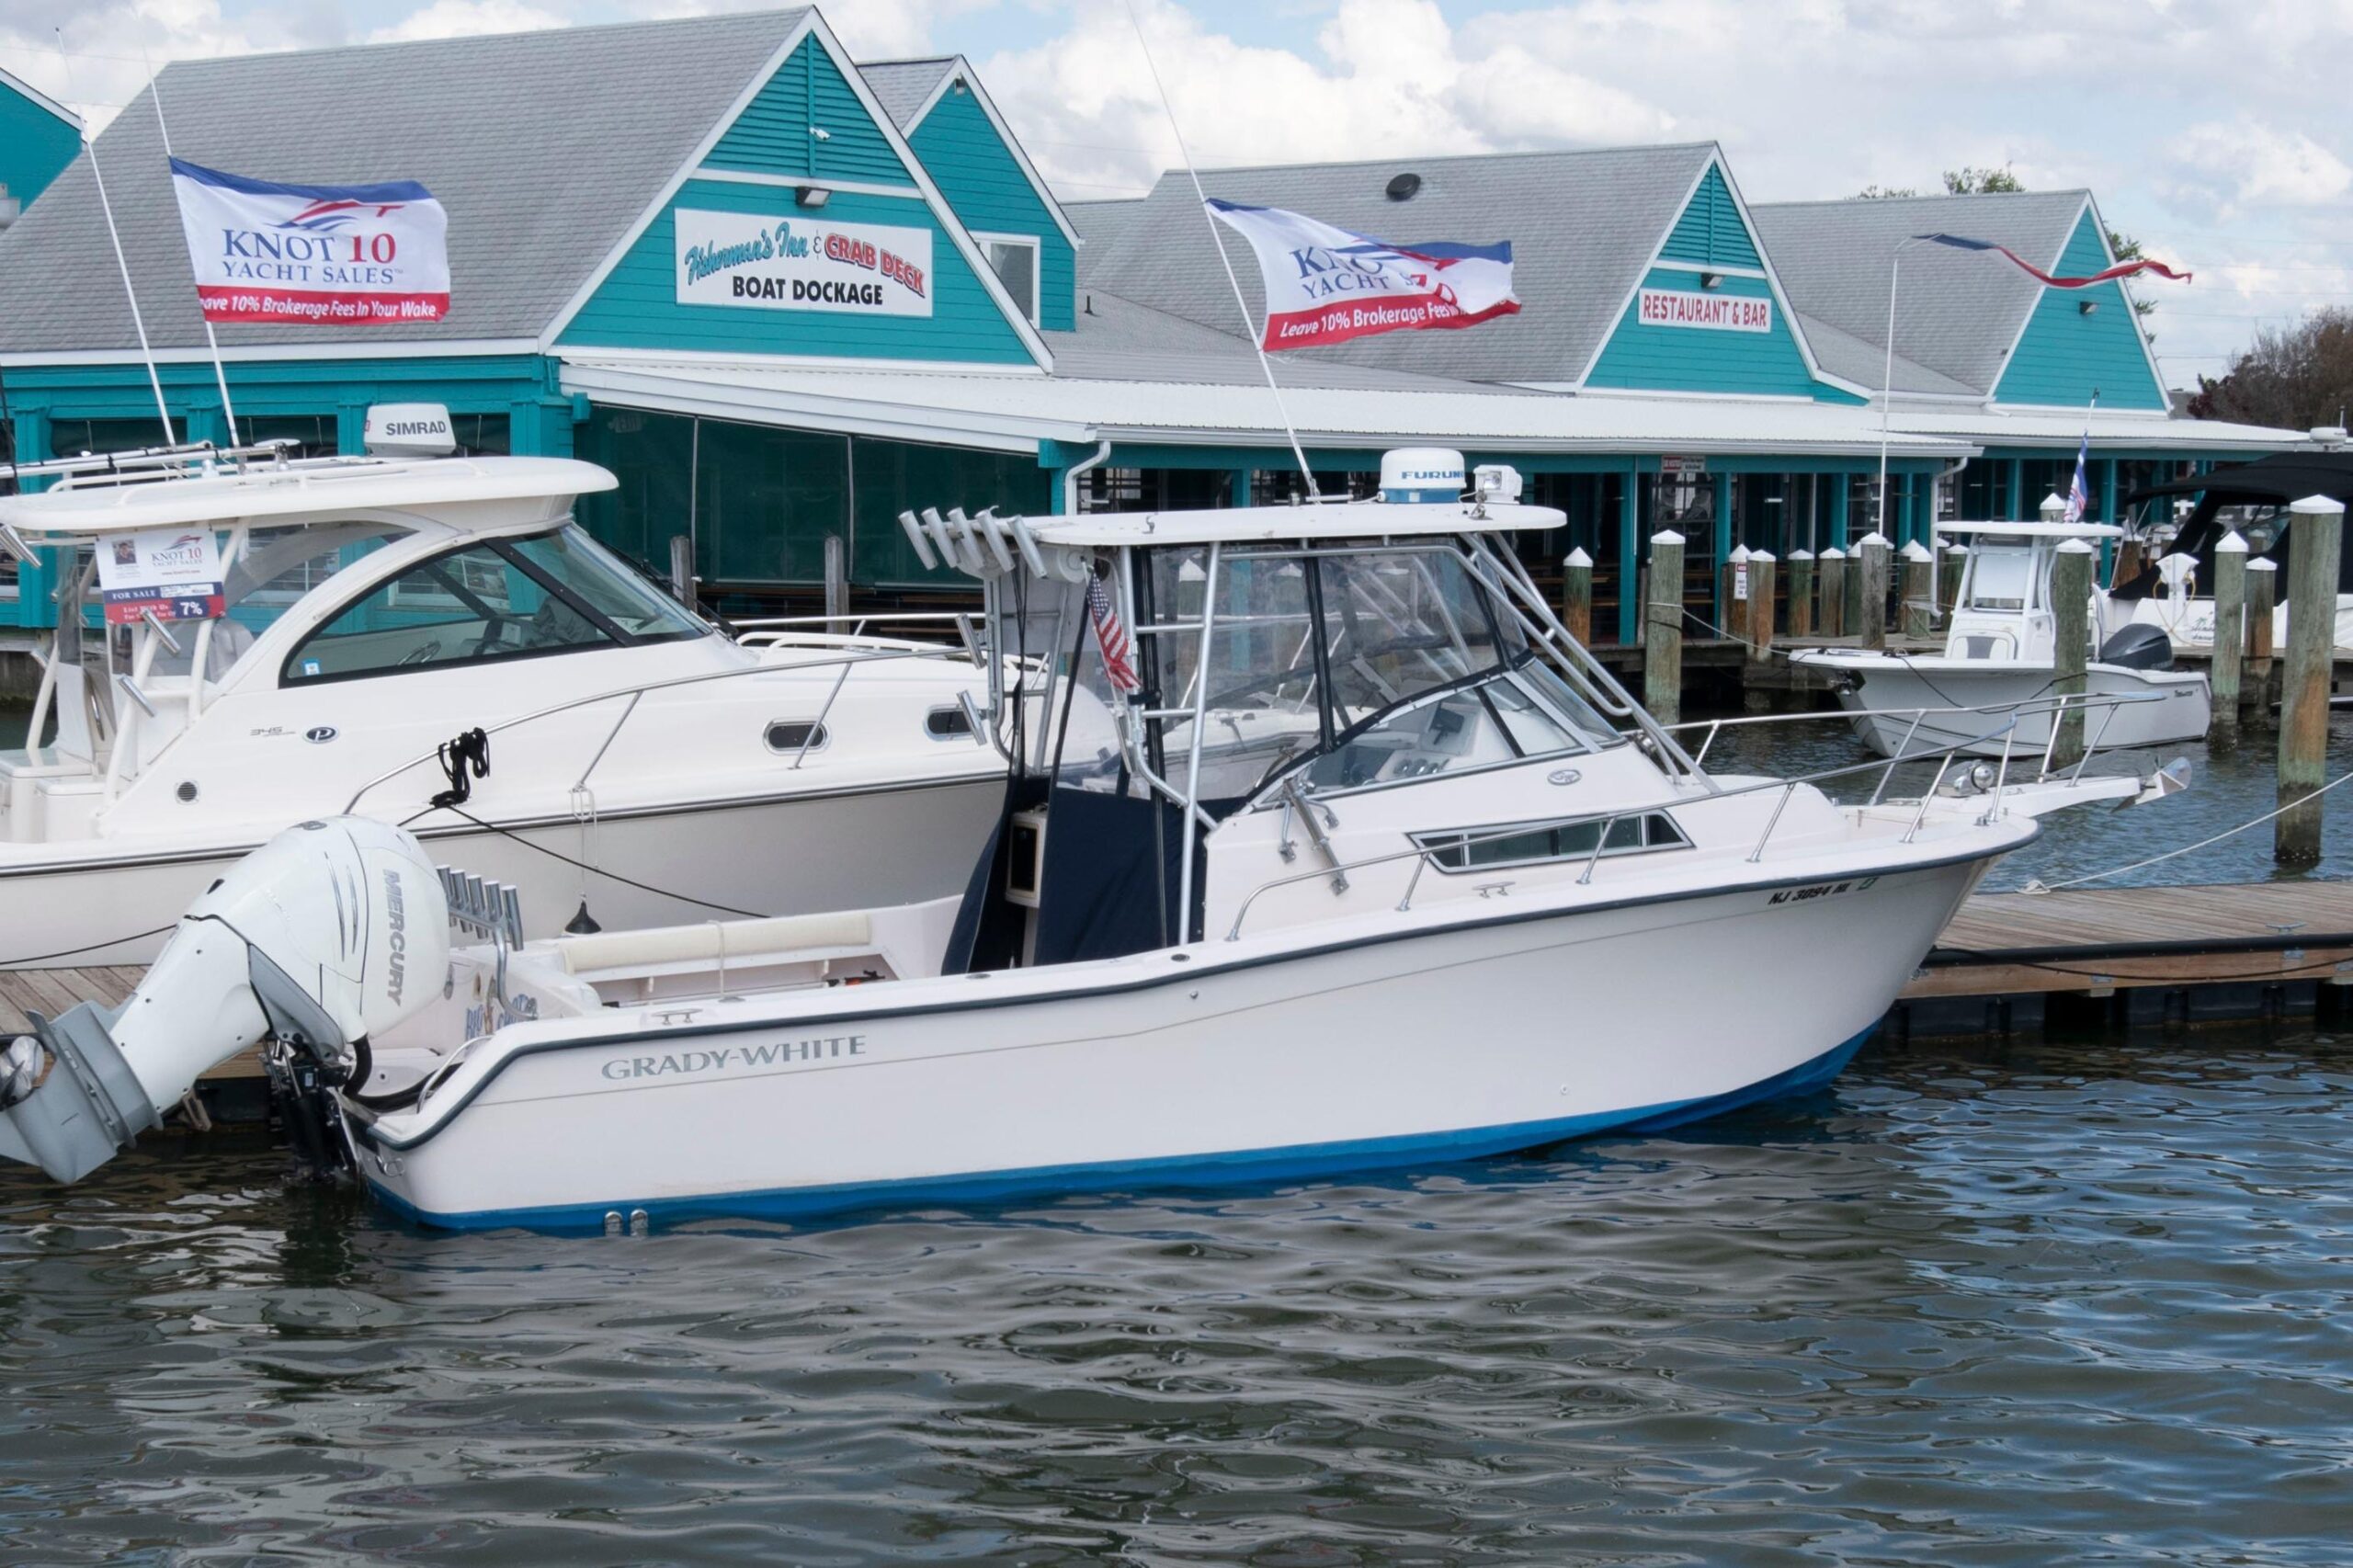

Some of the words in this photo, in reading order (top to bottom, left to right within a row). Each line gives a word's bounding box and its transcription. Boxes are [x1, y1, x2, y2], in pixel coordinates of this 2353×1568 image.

[222, 229, 335, 262] KNOT
[347, 233, 396, 264] 10
[685, 229, 774, 285] Fisherman's
[776, 221, 810, 259] Inn
[813, 229, 823, 260] &
[824, 233, 877, 269] CRAB
[881, 249, 926, 298] DECK
[223, 261, 313, 282] YACHT
[323, 267, 393, 284] SALES
[733, 276, 786, 299] BOAT
[792, 279, 883, 305] DOCKAGE
[1302, 273, 1390, 299] YACHT
[199, 297, 228, 311] eave
[232, 295, 260, 312] 10%
[262, 296, 328, 319] Brokerage
[331, 301, 356, 316] Fees
[357, 301, 369, 316] In
[371, 301, 399, 316] Your
[401, 301, 437, 316] Wake
[1643, 294, 1729, 324] RESTAURANT
[1732, 301, 1739, 324] &
[1743, 302, 1767, 326] BAR
[1279, 322, 1319, 338] Leave
[1321, 311, 1350, 332] 10%
[1353, 305, 1426, 327] Brokerage
[386, 420, 447, 436] SIMRAD
[151, 551, 184, 562] KNOT
[188, 547, 202, 559] 10
[132, 590, 156, 598] SALE
[180, 601, 203, 616] 7%
[1768, 891, 1791, 905] NJ
[382, 869, 405, 1007] MERCURY
[600, 1035, 867, 1081] GRADY-WHITE
